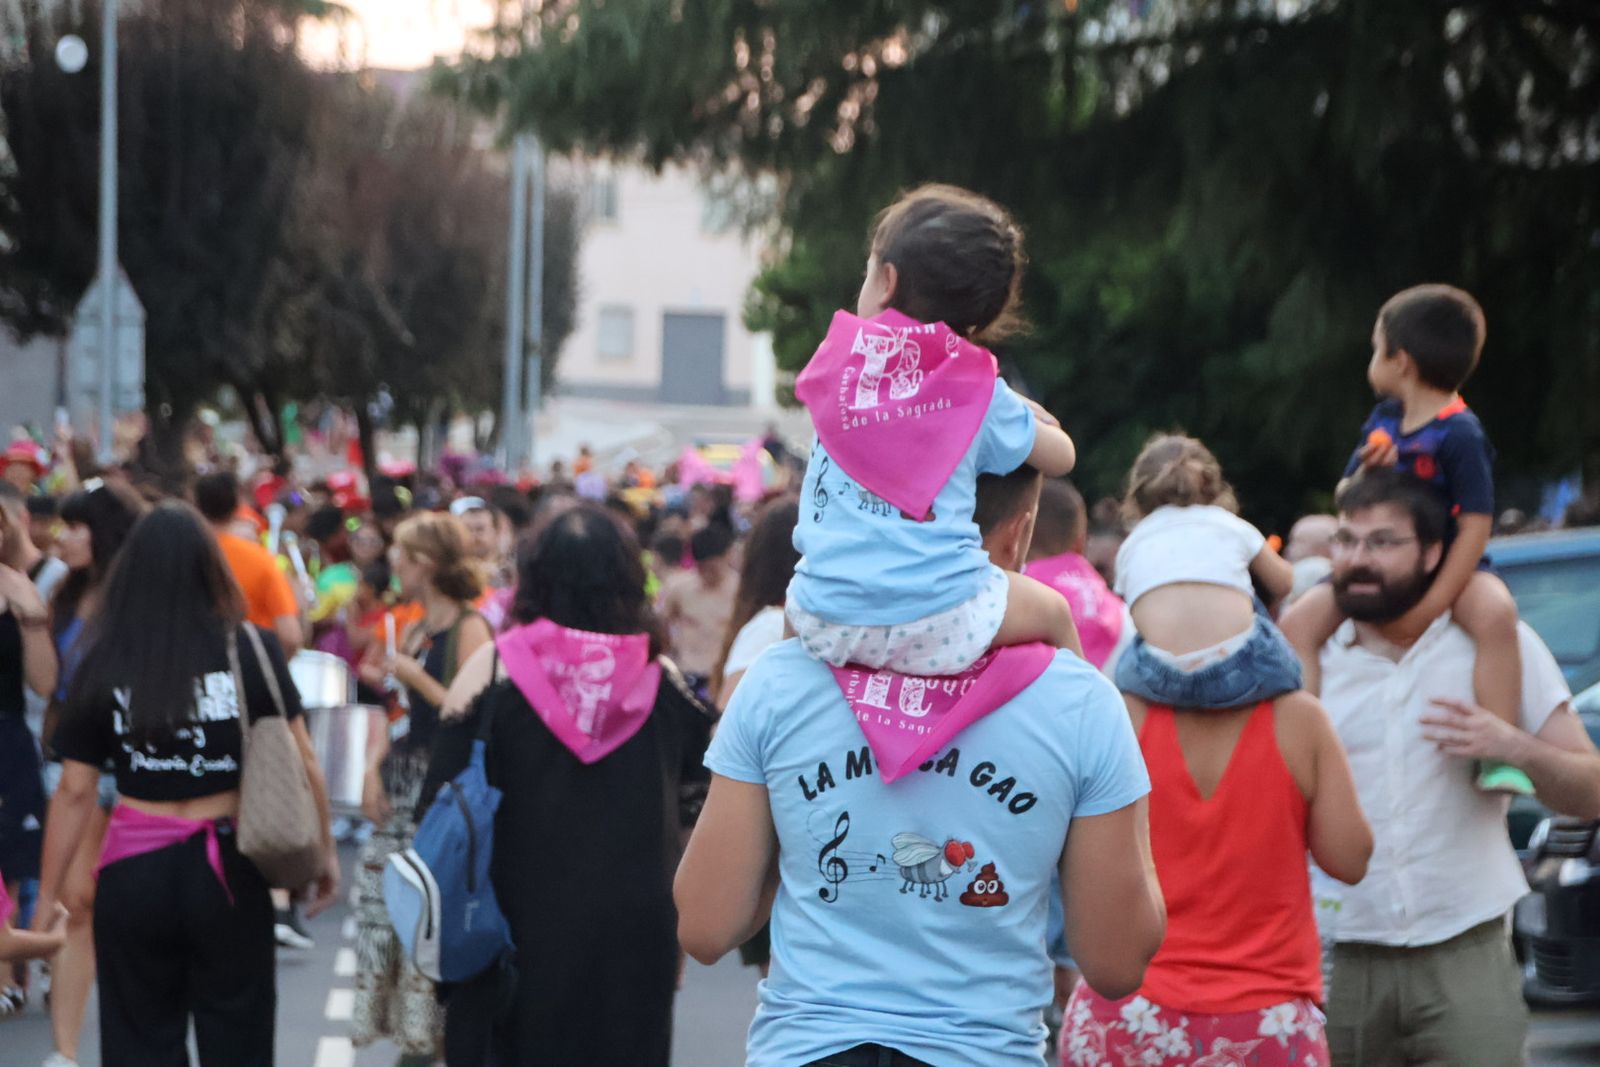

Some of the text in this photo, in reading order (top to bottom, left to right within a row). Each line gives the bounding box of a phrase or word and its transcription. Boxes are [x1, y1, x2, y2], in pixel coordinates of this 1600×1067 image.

[852, 397, 952, 428] de la Sagrada
[877, 714, 891, 726] la
[898, 720, 933, 735] Sagr
[797, 762, 836, 802] LA
[969, 761, 1038, 815] GAO
